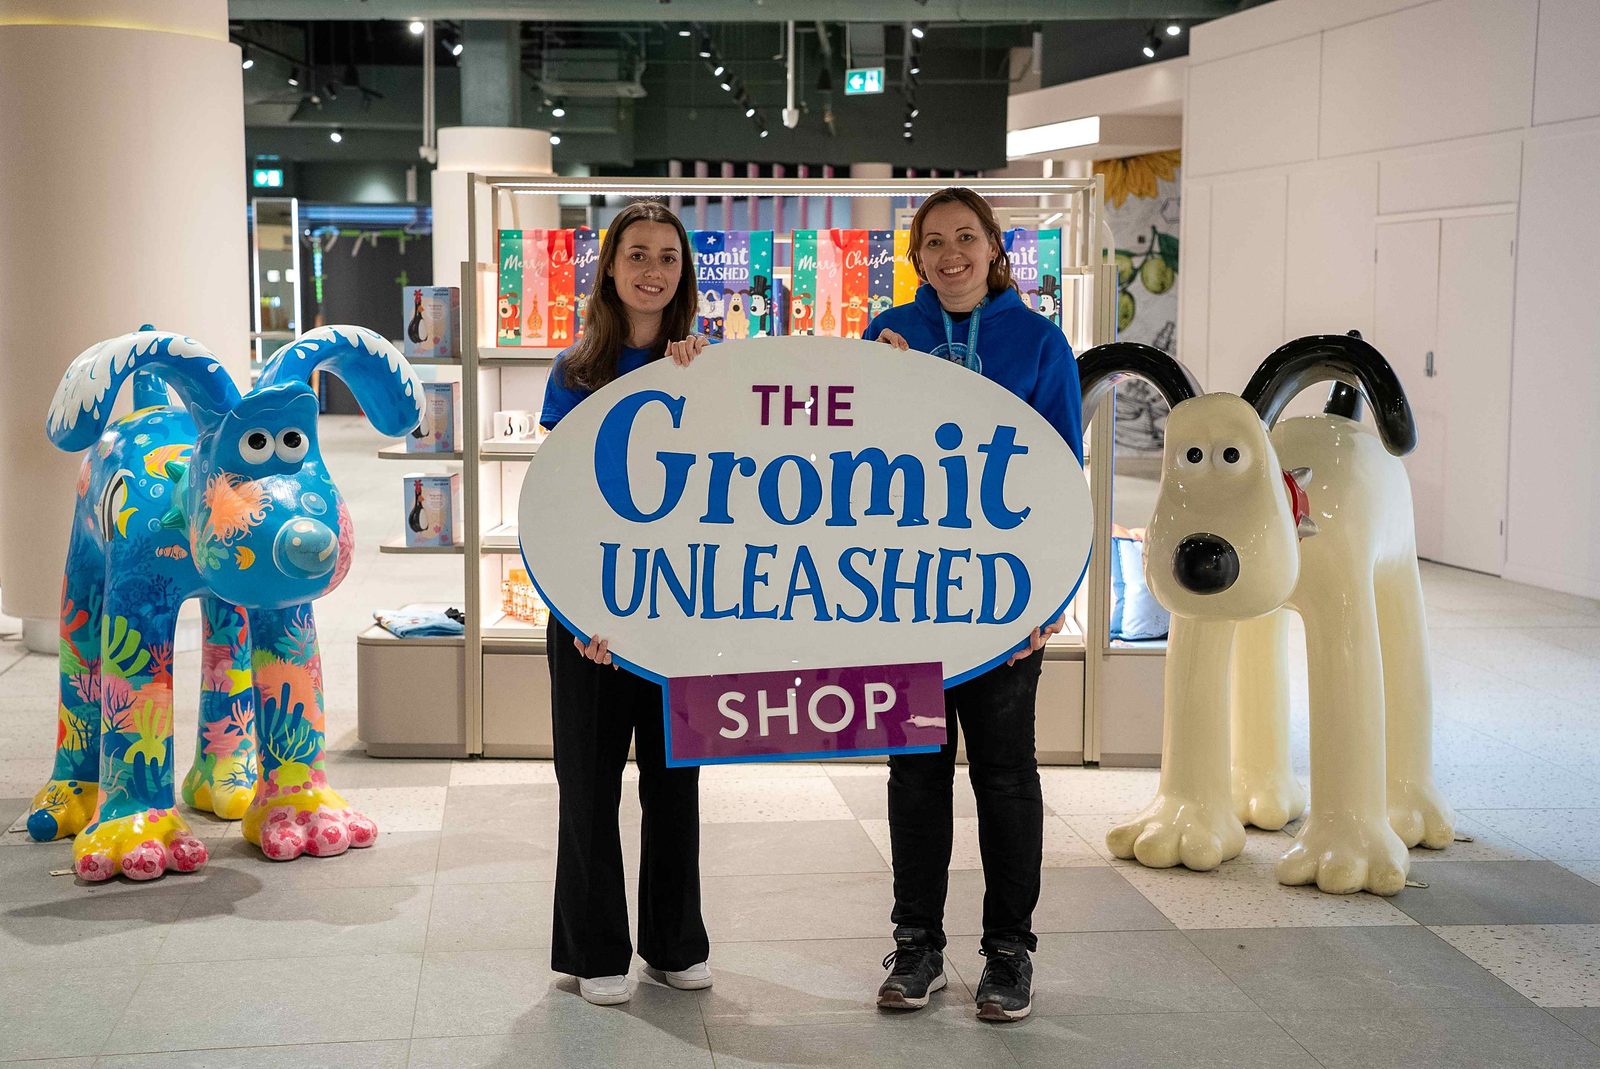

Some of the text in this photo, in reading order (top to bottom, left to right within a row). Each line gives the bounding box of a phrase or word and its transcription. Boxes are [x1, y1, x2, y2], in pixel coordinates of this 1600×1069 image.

[692, 247, 749, 266] romit
[797, 254, 839, 278] Merry
[752, 385, 855, 427] THE
[593, 389, 1032, 530] Gromit
[599, 542, 1033, 626] UNLEASHED
[716, 682, 898, 740] SHOP
